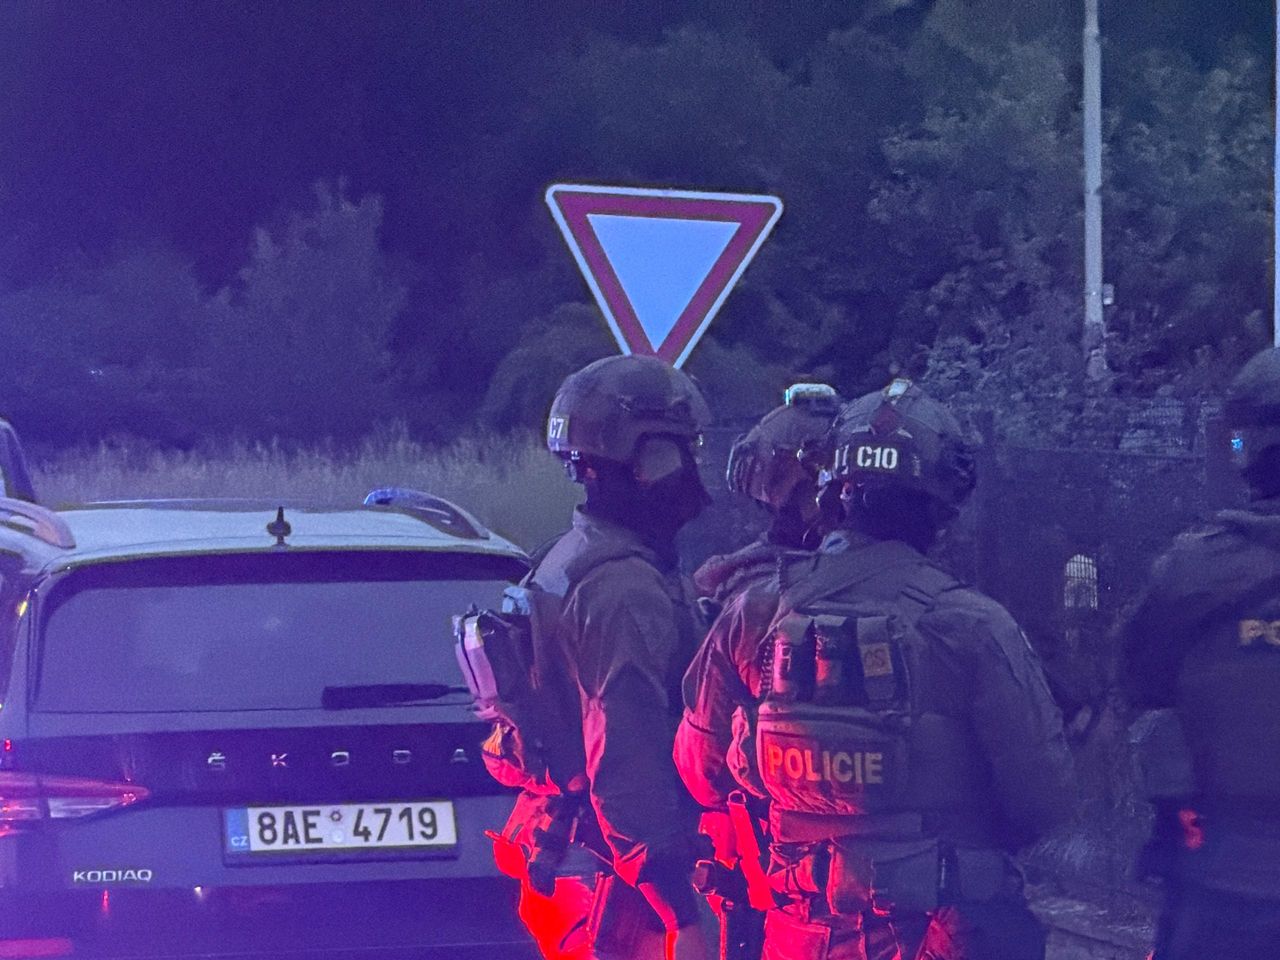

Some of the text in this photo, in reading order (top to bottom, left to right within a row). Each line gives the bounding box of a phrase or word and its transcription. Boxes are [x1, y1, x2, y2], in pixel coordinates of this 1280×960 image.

[550, 417, 564, 439] C7
[857, 446, 898, 469] C10
[766, 743, 884, 784] POLICIE
[257, 807, 439, 846] 8AE 4719
[231, 836, 248, 847] CZ
[73, 869, 153, 882] KODIAQ
